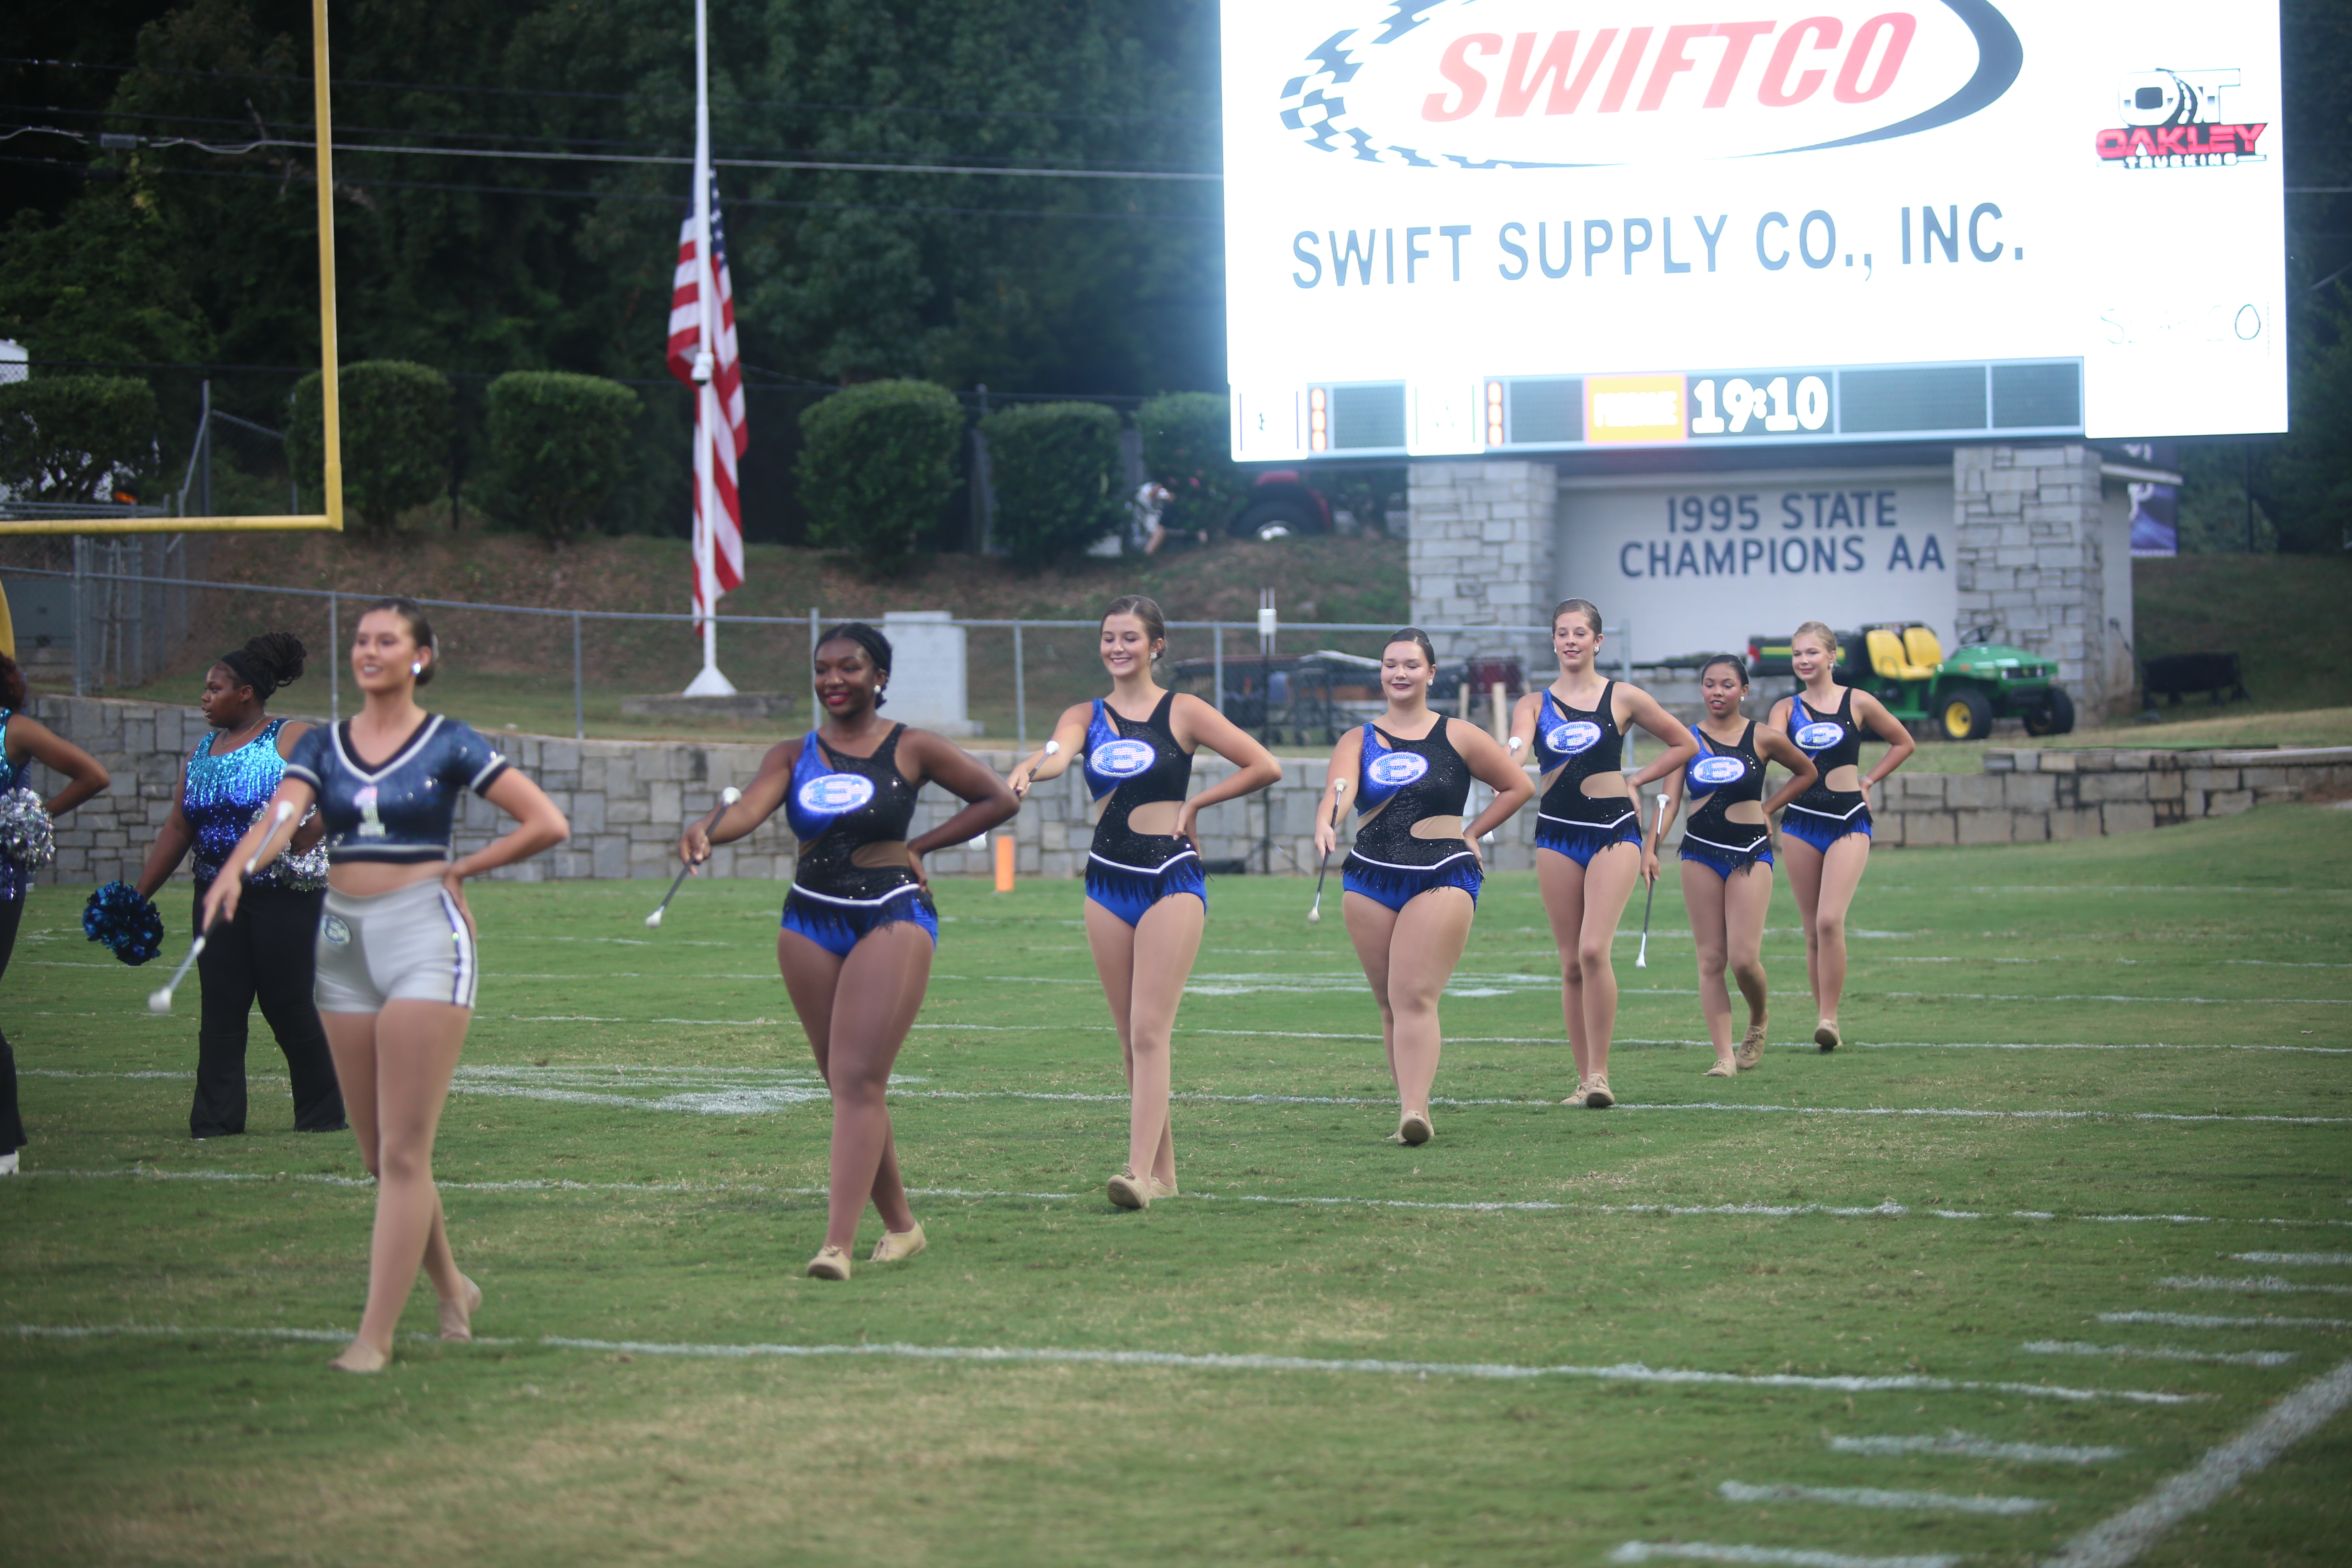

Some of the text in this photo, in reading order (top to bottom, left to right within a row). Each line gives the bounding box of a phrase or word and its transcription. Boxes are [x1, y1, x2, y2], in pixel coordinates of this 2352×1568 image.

[1421, 12, 1917, 122] SWIFTCO
[2096, 124, 2265, 158] OAKLEY
[1292, 202, 2023, 289] SWIFT SUPPLY CO., INC.
[1692, 376, 1829, 434] 19:10
[1667, 491, 1897, 534] 1995 STATE
[1620, 534, 1946, 578] CHAMPIONS AA
[353, 786, 385, 837] 1
